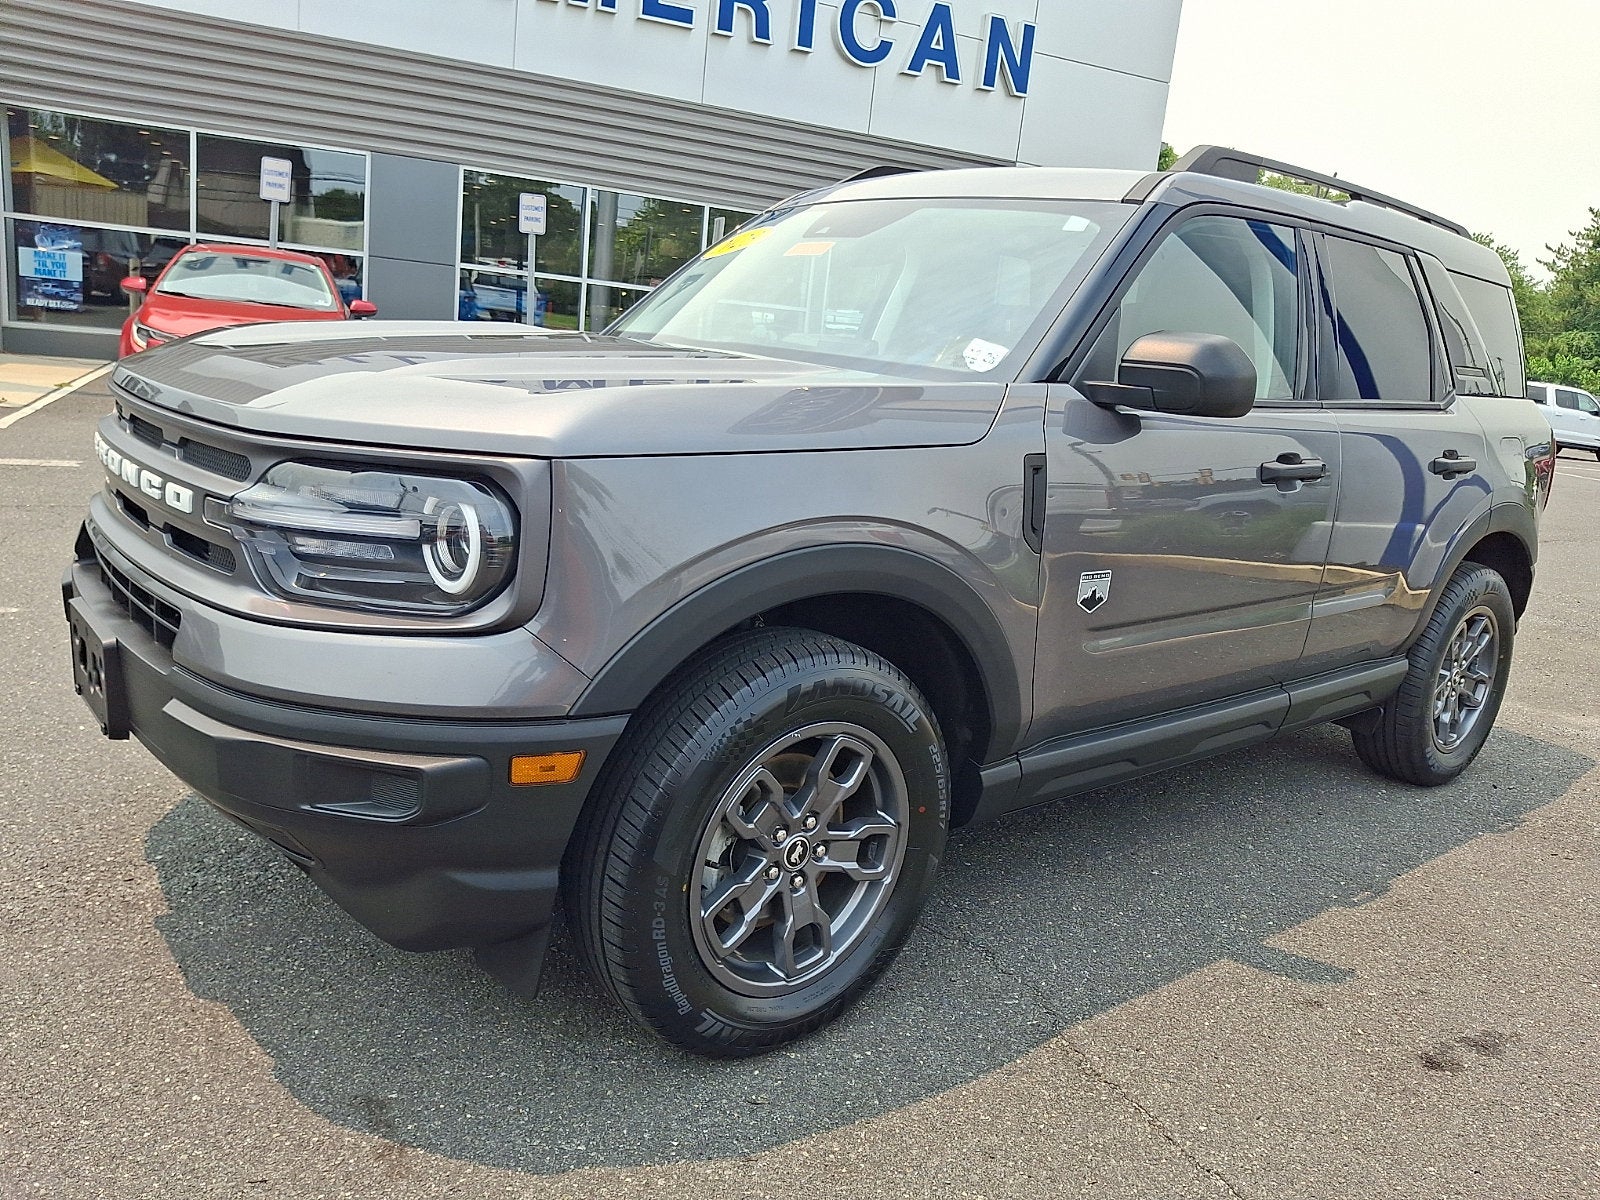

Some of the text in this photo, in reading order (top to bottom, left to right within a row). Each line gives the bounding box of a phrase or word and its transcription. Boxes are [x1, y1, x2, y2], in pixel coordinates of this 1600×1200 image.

[33, 250, 66, 261] MAKE IT
[51, 261, 67, 270] YOU
[34, 268, 67, 278] MAKE IT
[94, 431, 194, 514] BRONCO
[784, 677, 923, 734] LANDSAIL
[656, 941, 694, 1017] RapidDragon
